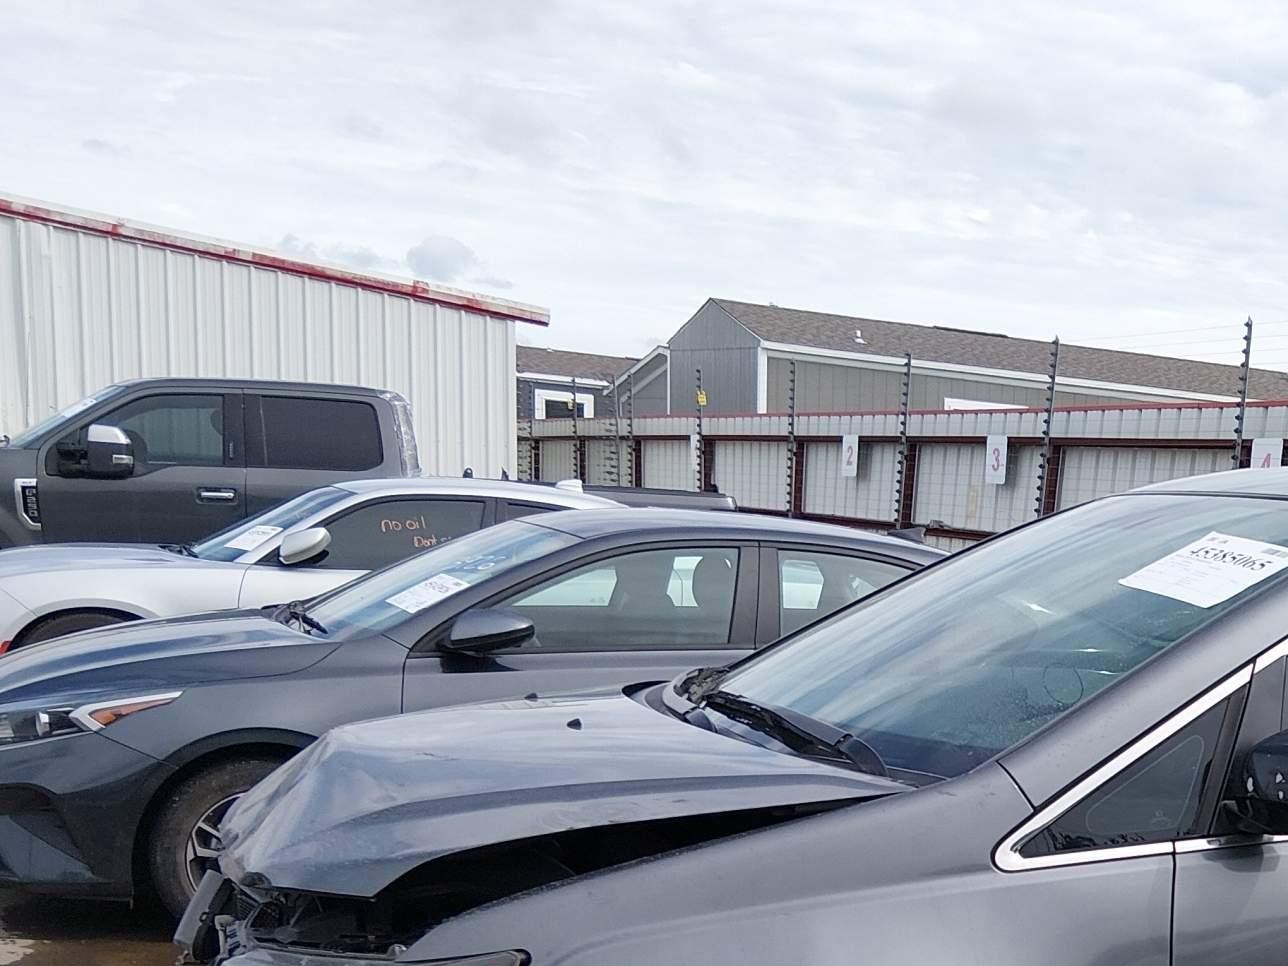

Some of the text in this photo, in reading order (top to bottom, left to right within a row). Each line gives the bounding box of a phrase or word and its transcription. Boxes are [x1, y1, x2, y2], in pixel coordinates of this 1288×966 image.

[846, 446, 854, 466] 2
[991, 447, 1001, 472] 3
[406, 515, 426, 530] oil
[1190, 546, 1273, 571] 45385065
